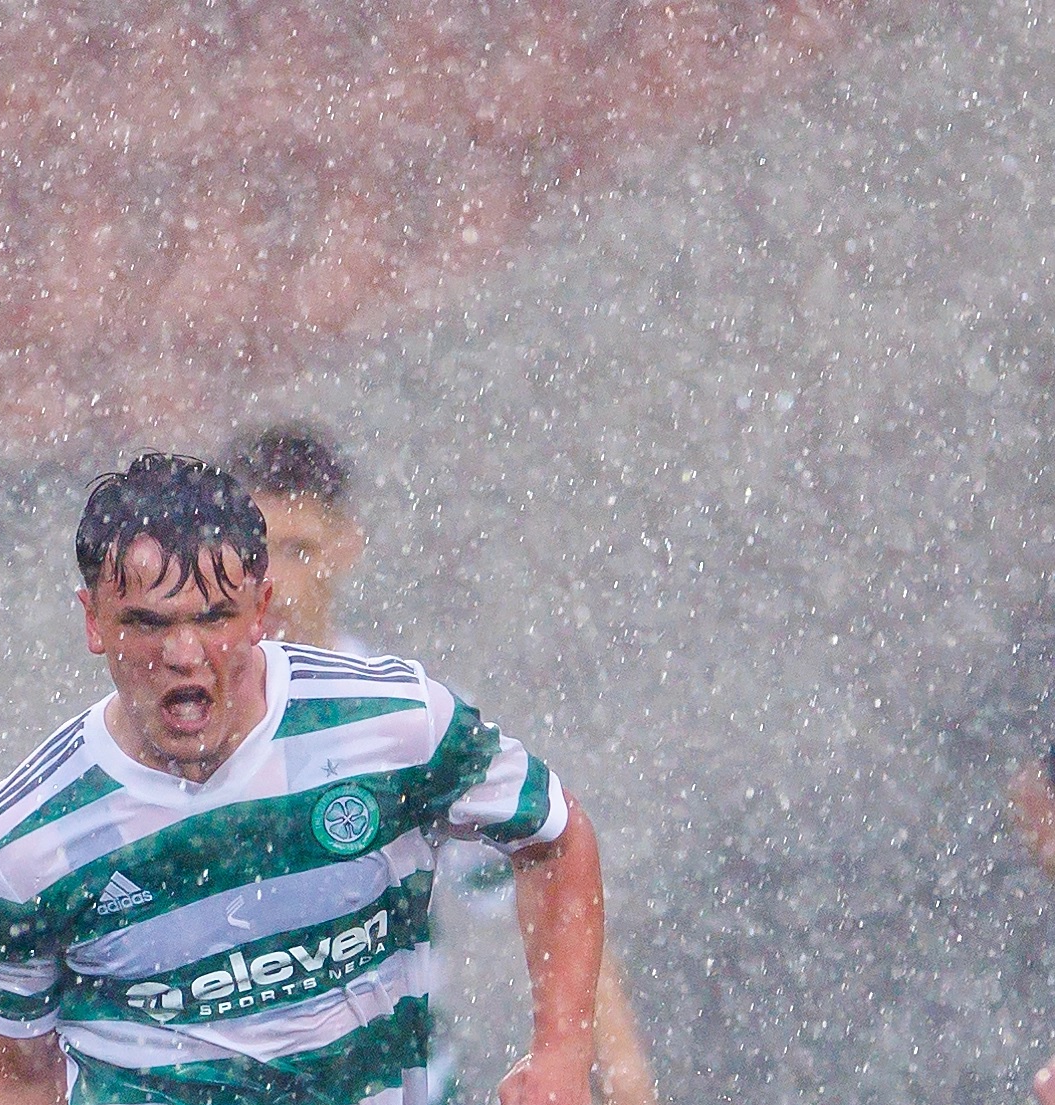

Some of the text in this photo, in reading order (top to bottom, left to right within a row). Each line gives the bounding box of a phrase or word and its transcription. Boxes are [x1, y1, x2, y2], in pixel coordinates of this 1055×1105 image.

[97, 890, 153, 915] adidas
[190, 909, 389, 1001] eleven
[199, 977, 318, 1016] SPORTS
